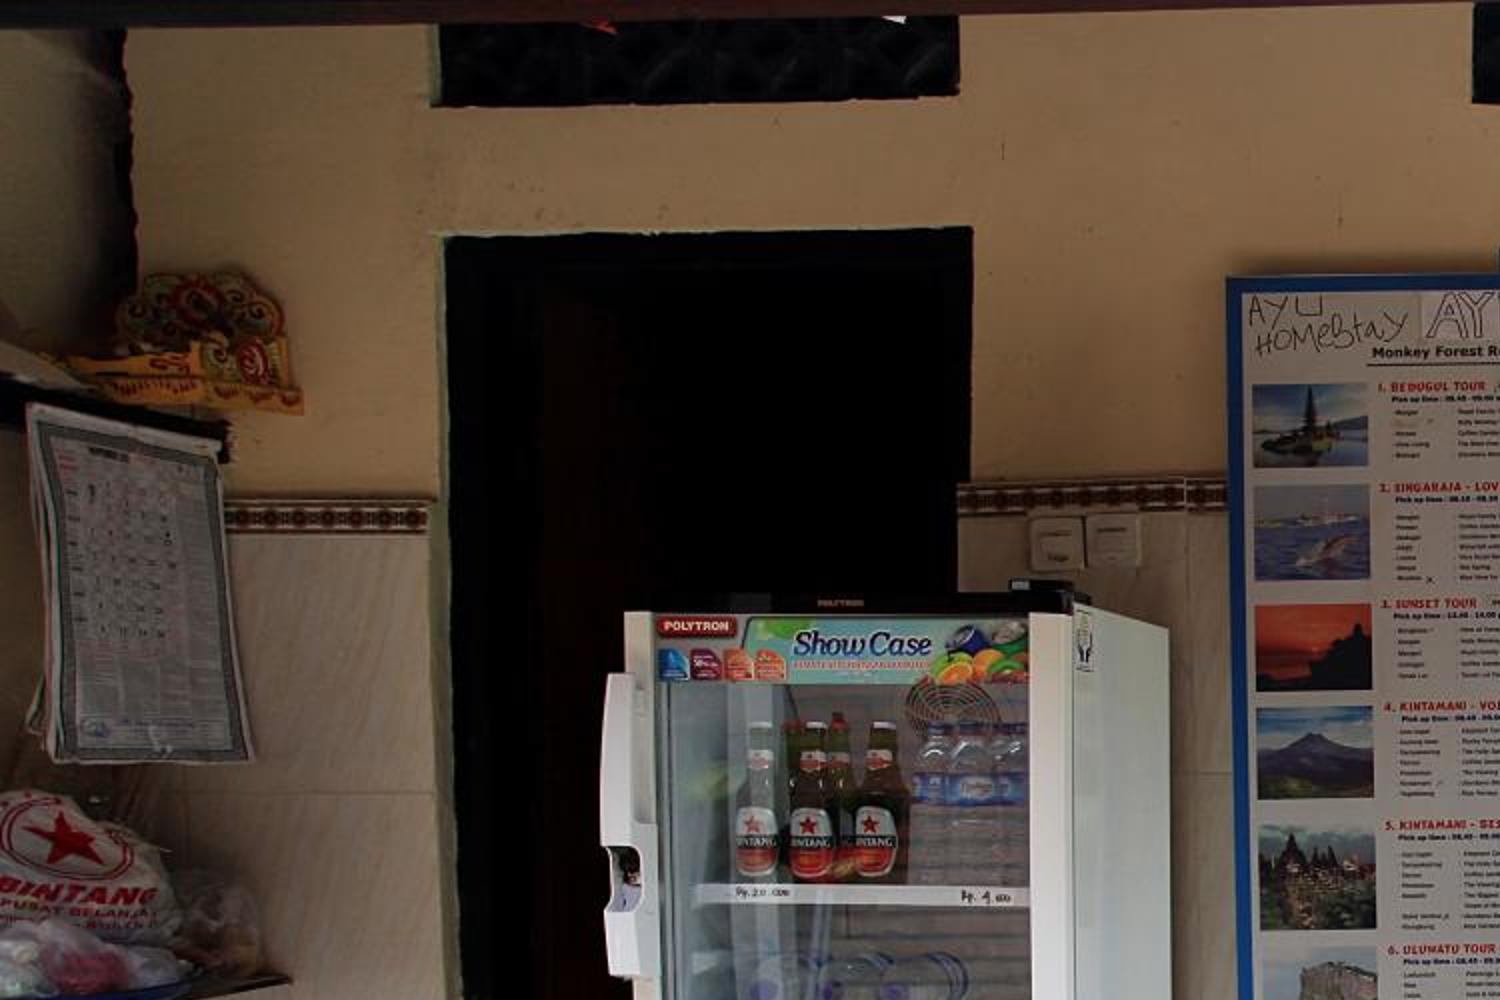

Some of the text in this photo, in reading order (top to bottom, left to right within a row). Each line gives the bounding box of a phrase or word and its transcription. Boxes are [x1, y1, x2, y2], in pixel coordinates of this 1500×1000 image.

[1373, 347, 1431, 360] Monkey
[1436, 345, 1483, 358] Forest
[1445, 598, 1477, 608] TOUR
[664, 621, 729, 631] POLYTRON
[794, 629, 932, 656] Show Case
